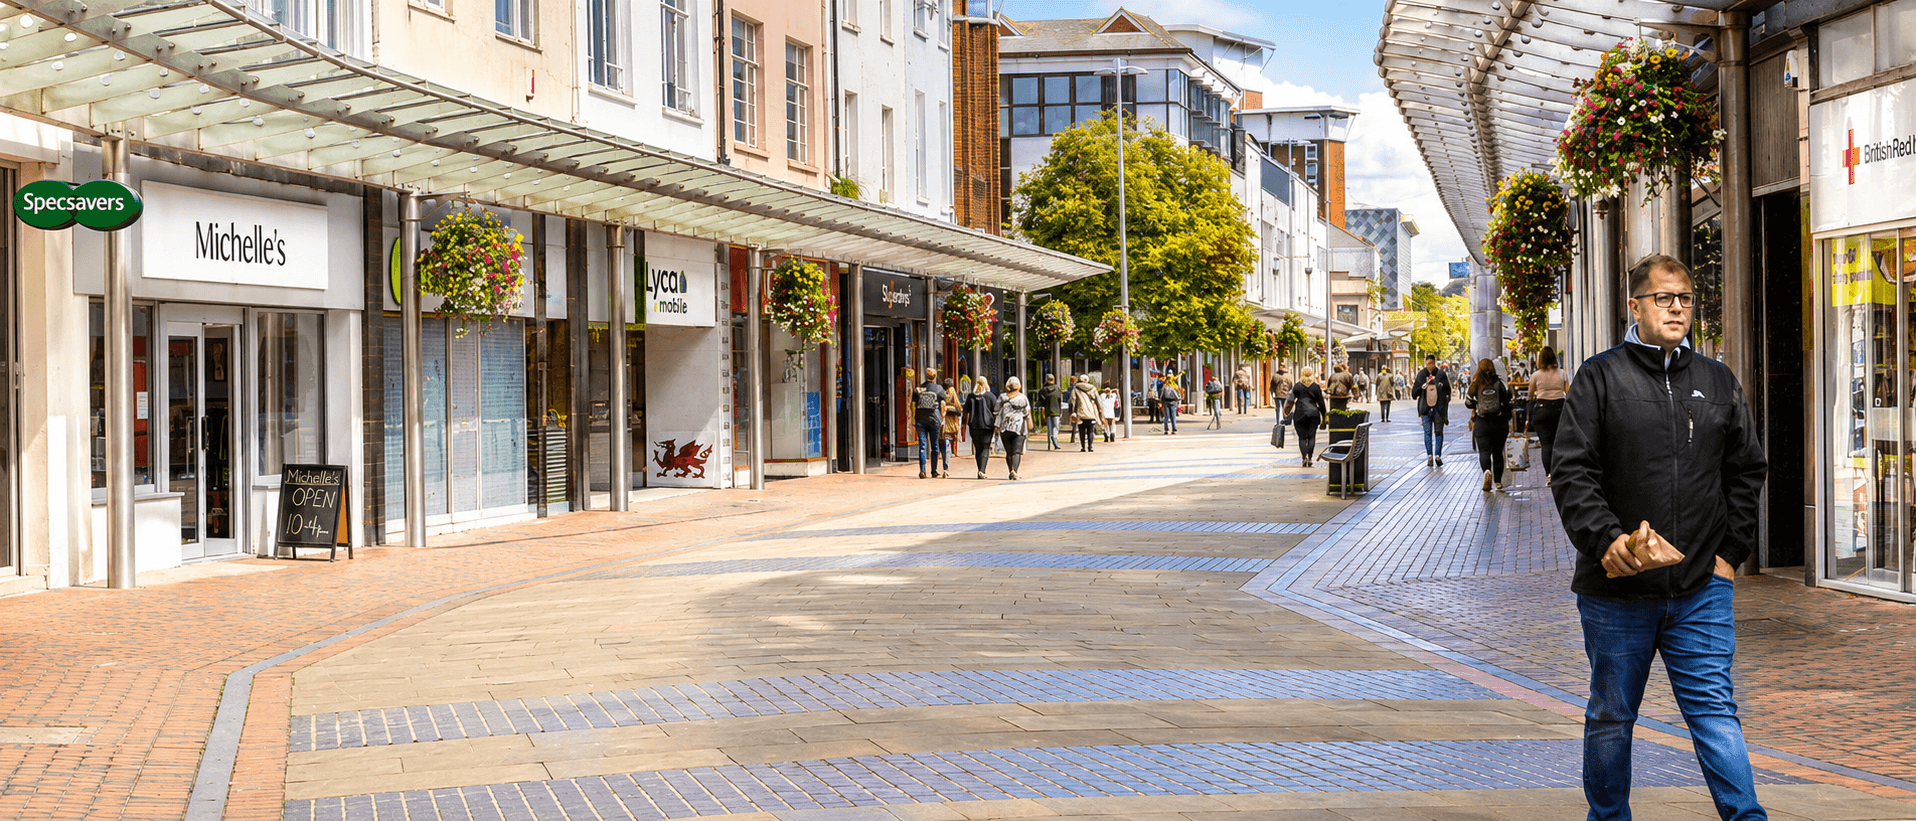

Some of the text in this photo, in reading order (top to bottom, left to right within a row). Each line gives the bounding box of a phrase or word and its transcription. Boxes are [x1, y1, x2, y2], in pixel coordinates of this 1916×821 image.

[23, 193, 124, 214] Specsavers
[195, 221, 286, 266] Michelle's
[645, 262, 678, 300] Lyca
[659, 298, 688, 314] mobile
[286, 469, 339, 484] Michelle's
[292, 487, 336, 508] OPEN
